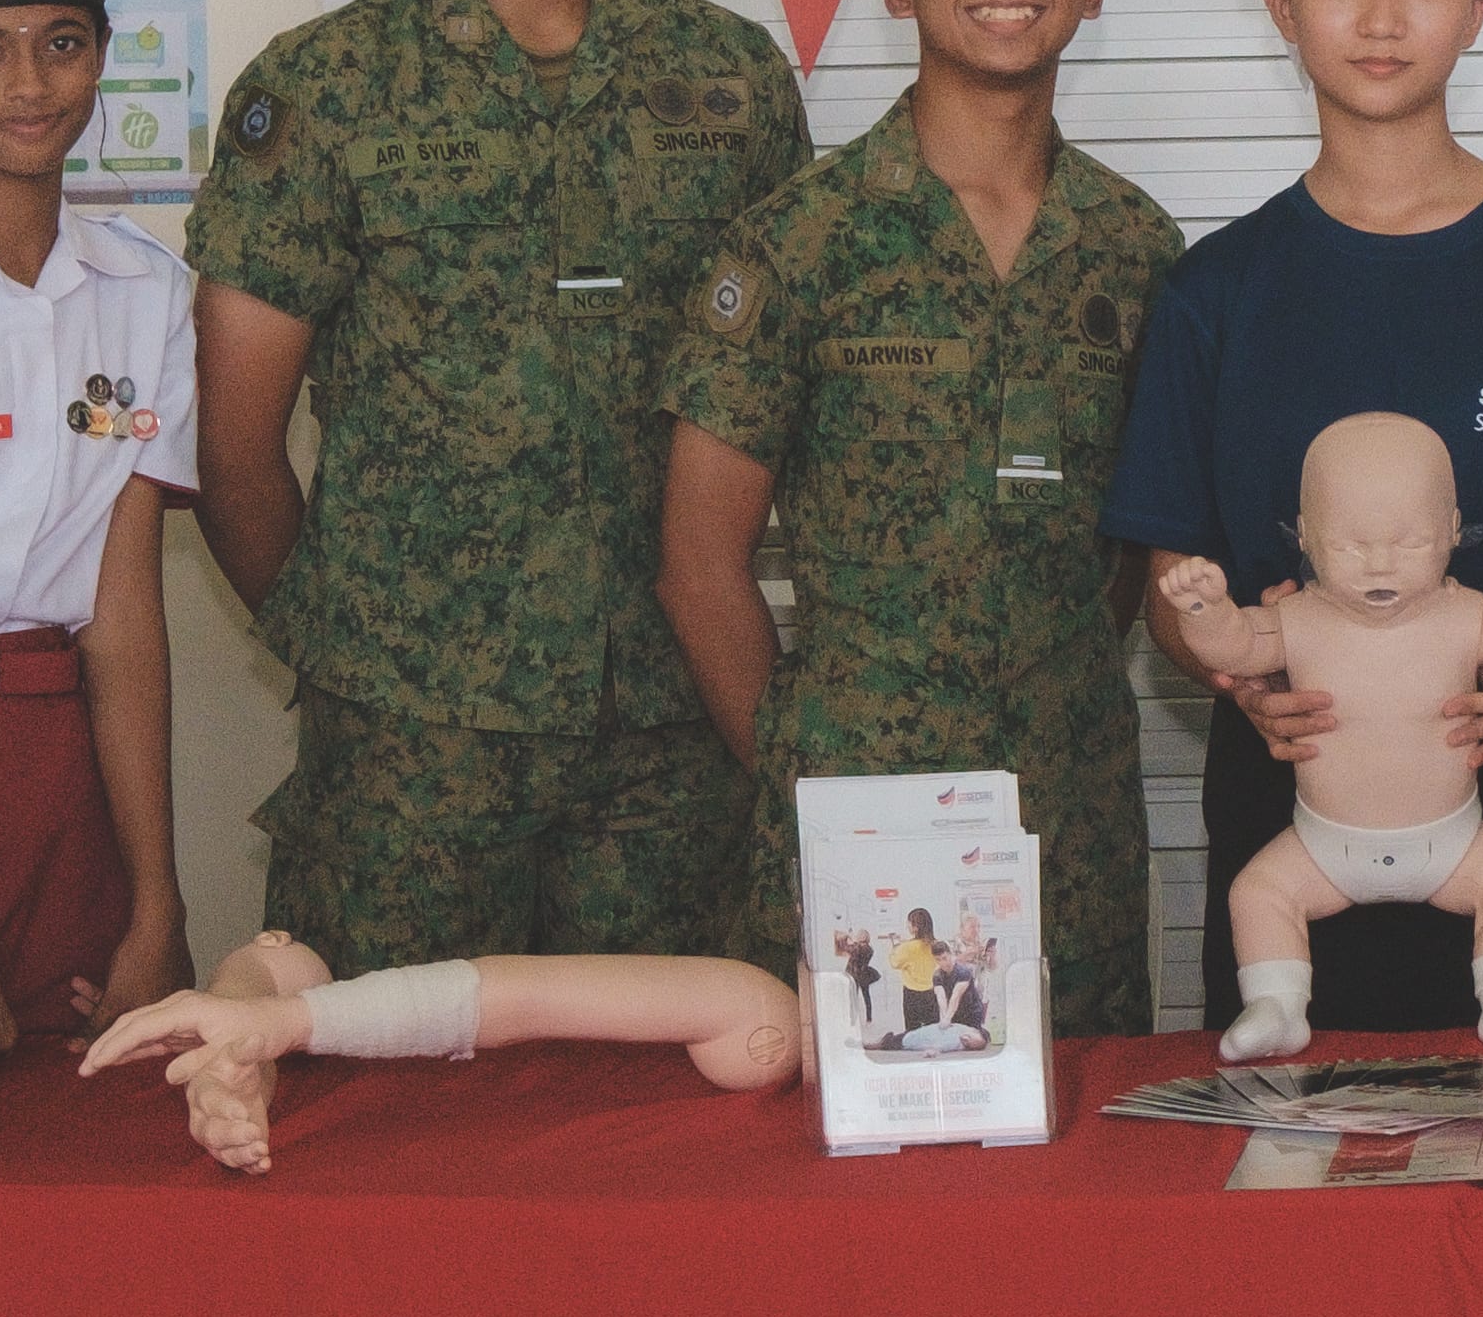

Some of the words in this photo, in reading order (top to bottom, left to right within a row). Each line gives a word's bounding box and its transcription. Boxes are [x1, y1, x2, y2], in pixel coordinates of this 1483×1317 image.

[375, 144, 406, 168] ARI
[418, 140, 481, 163] SYUKRI
[573, 292, 617, 311] NCC
[842, 345, 938, 368] DARWISY
[1010, 482, 1051, 502] NCC
